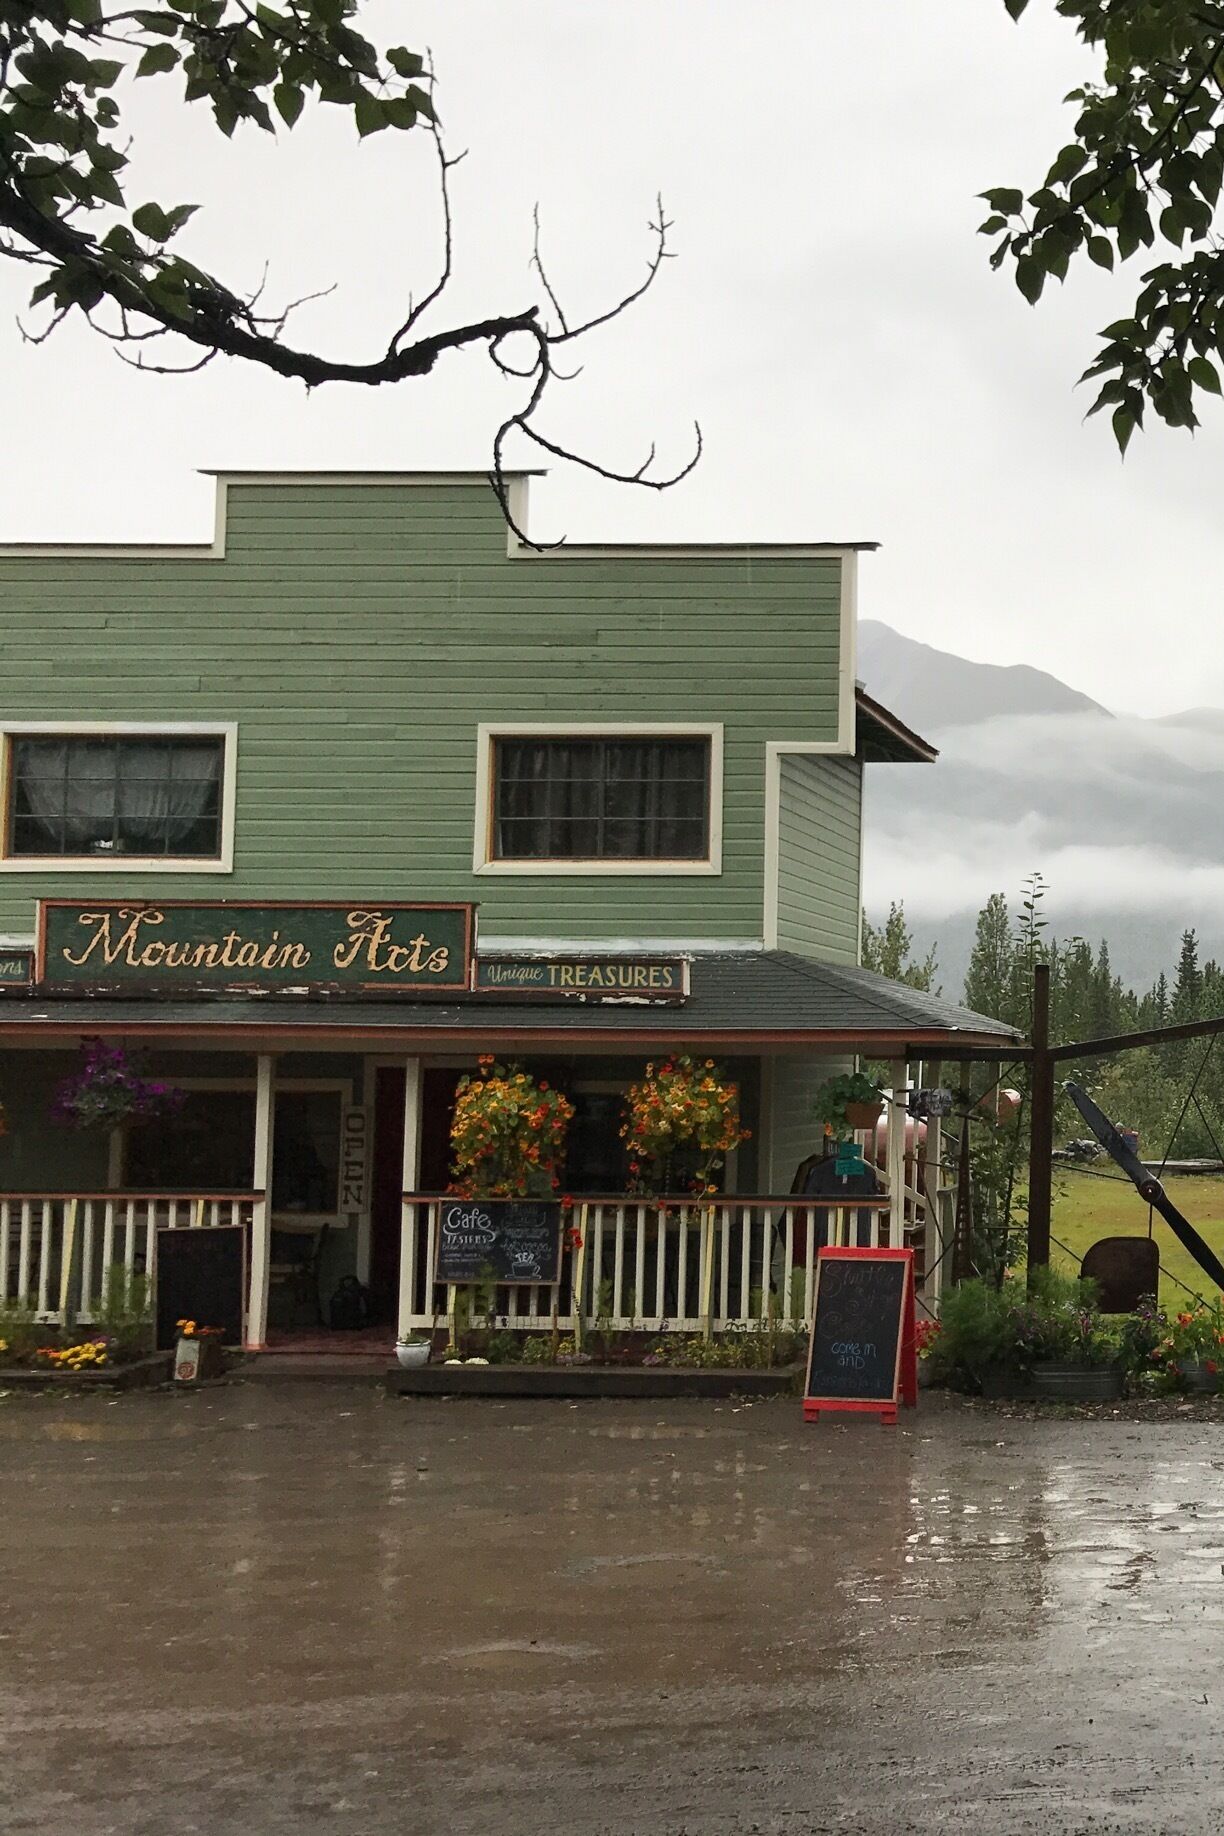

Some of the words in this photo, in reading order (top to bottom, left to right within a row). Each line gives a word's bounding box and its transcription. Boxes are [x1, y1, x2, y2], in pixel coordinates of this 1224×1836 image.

[63, 908, 311, 969] Mountain
[333, 910, 450, 973] Arts
[487, 963, 544, 984] Unique
[547, 964, 673, 987] TREASURES
[343, 1112, 366, 1205] OPEN
[446, 1206, 493, 1230] Cafe
